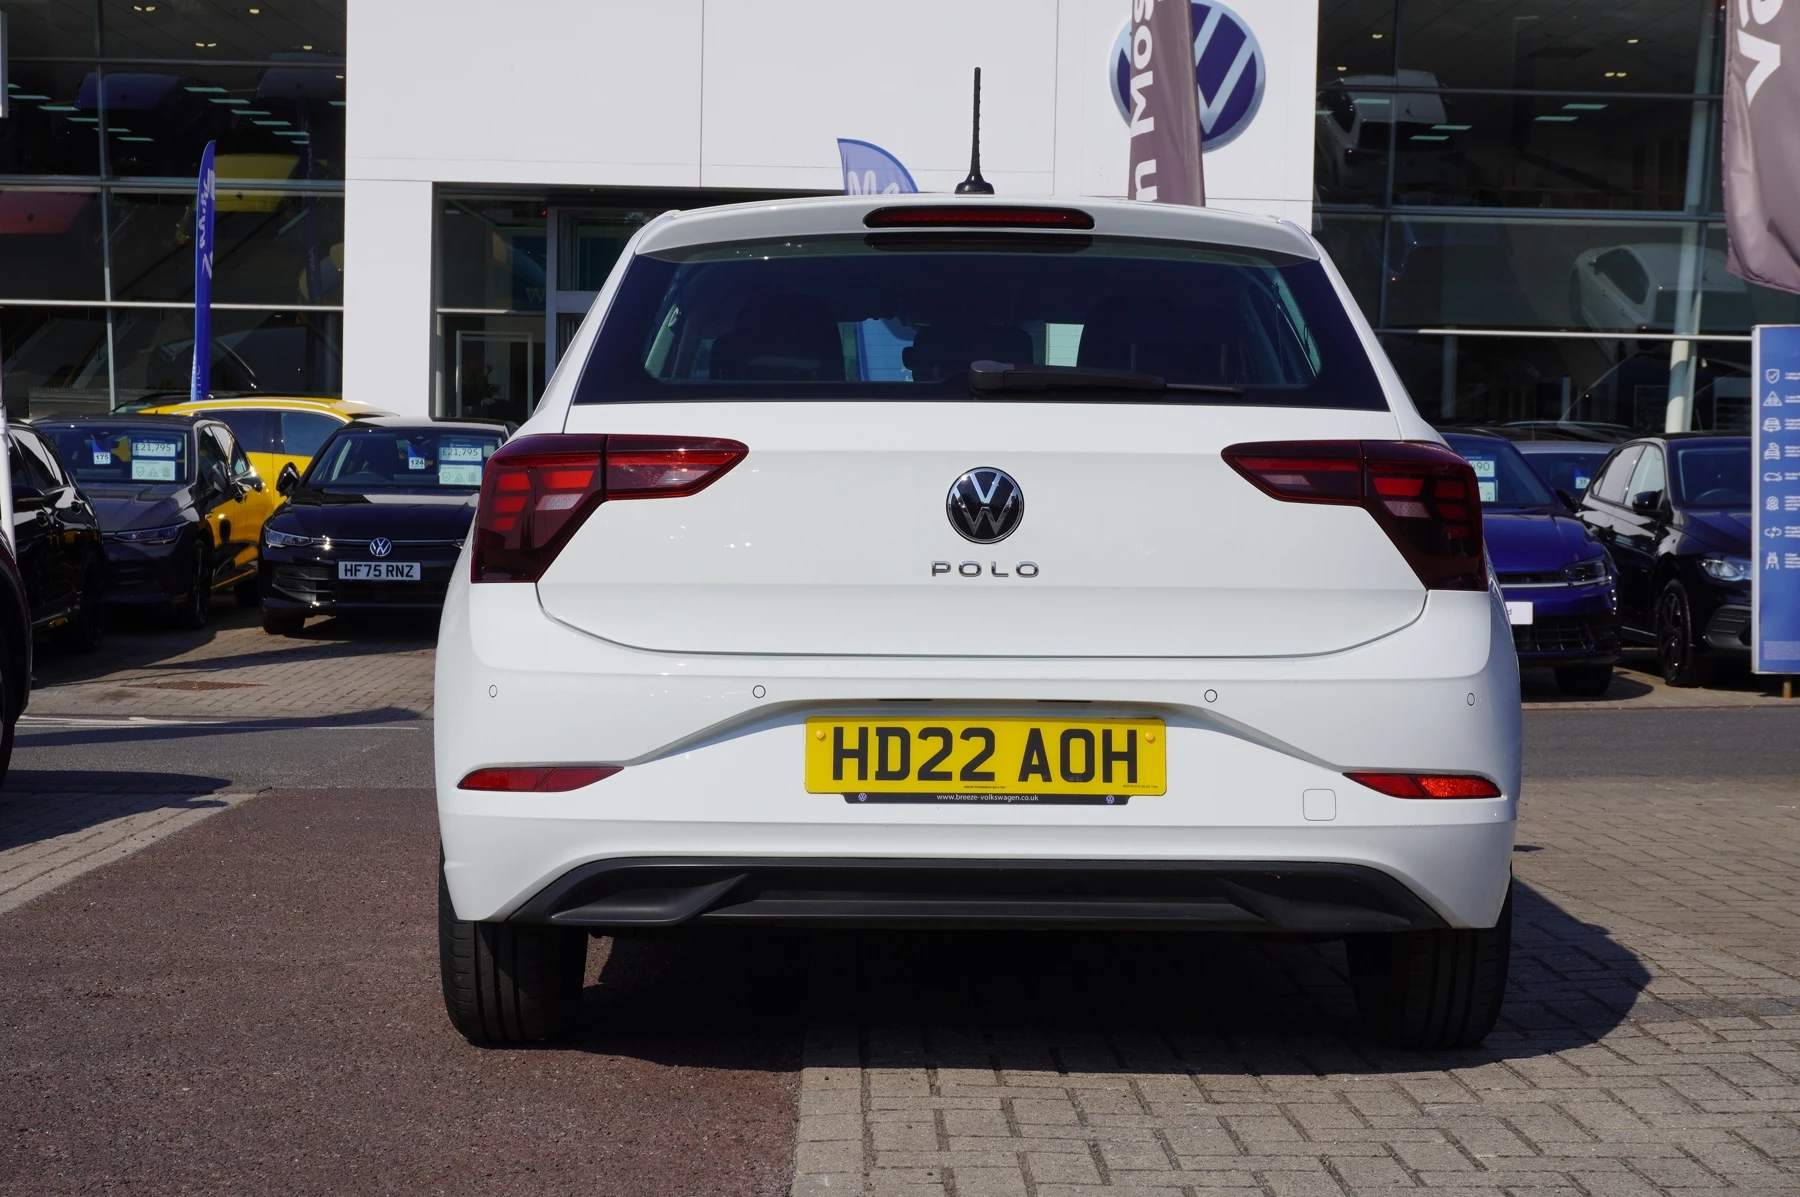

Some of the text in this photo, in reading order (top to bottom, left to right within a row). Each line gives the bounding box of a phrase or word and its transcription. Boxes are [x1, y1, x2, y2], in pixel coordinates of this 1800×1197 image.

[135, 443, 172, 453] £21,795
[442, 448, 479, 457] £21,795
[343, 563, 414, 578] HF75 RNZ
[931, 560, 1040, 578] POLO
[832, 726, 1138, 784] HD22 AOH
[936, 793, 1039, 803] www.breeze-volkswagen.co.uk
